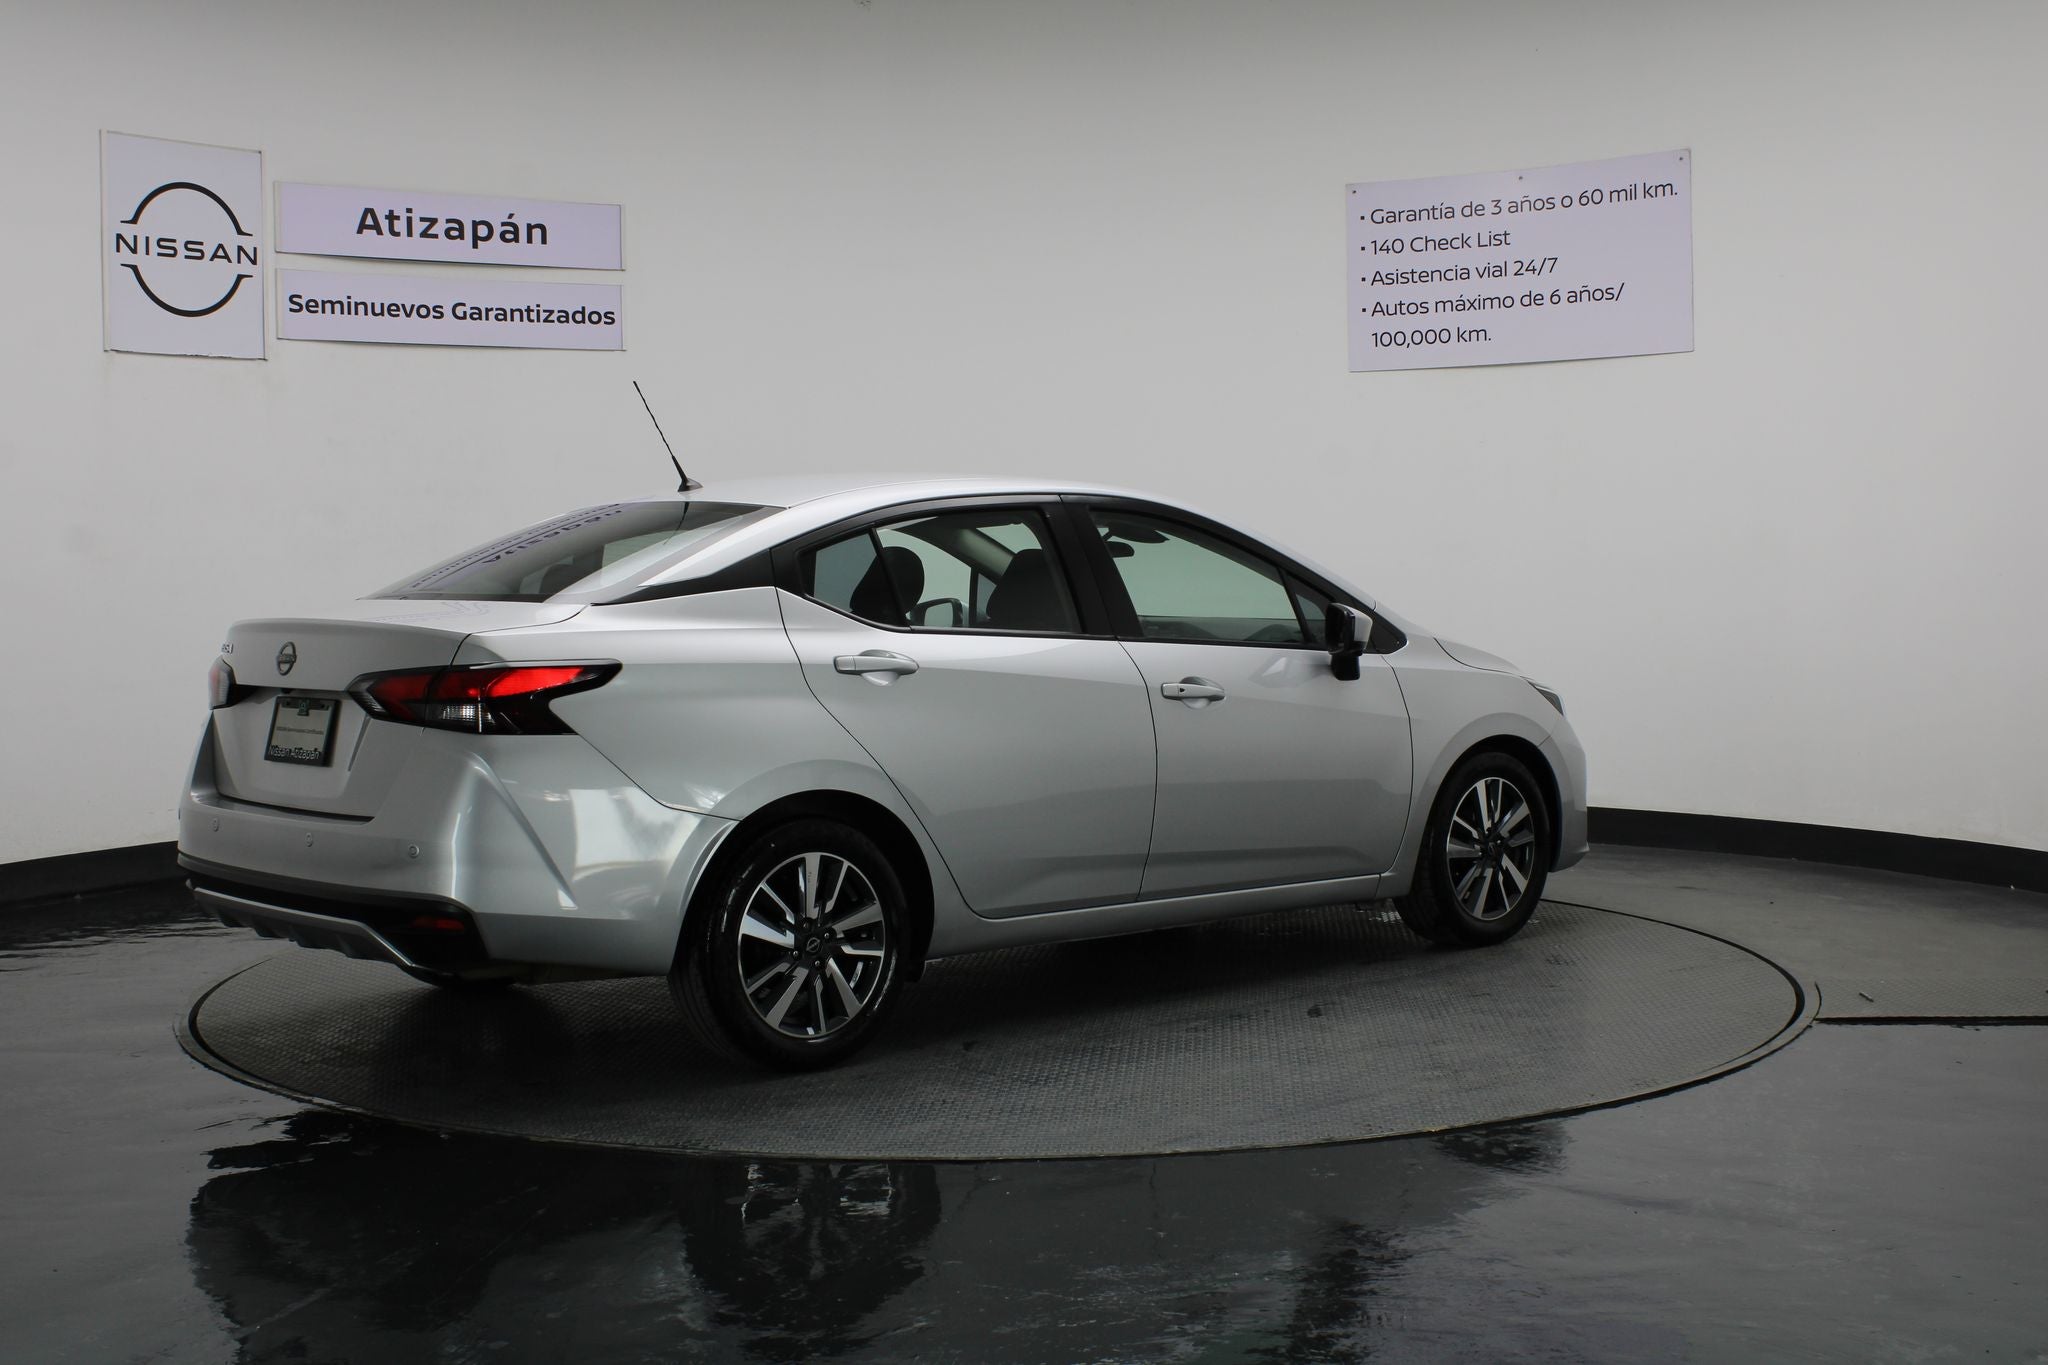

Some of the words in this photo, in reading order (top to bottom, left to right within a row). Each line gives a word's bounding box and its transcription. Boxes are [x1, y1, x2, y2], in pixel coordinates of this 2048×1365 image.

[1370, 202, 1455, 225] Garantía
[1460, 200, 1486, 218] de
[1490, 199, 1503, 216] 3
[1507, 195, 1556, 214] años
[1560, 195, 1574, 209] o
[1578, 188, 1604, 207] 60
[1609, 183, 1637, 203] mil
[1643, 182, 1678, 200] km.
[356, 207, 548, 250] Atizapán
[1370, 238, 1405, 256] 140
[1409, 232, 1472, 253] Check
[1477, 230, 1511, 248] List
[115, 232, 258, 266] NISSAN
[1370, 264, 1471, 287] Asistencia
[1475, 260, 1508, 279] vial
[1513, 257, 1559, 277] 24/7
[288, 293, 445, 320] Seminuevos
[451, 302, 616, 326] Garantizados
[1371, 300, 1430, 318] Autos
[1434, 294, 1515, 313] máximo
[1519, 290, 1545, 308] de
[1549, 288, 1562, 305] 6
[1566, 282, 1625, 304] años/
[1371, 328, 1452, 349] 100,000
[1456, 326, 1492, 343] km.
